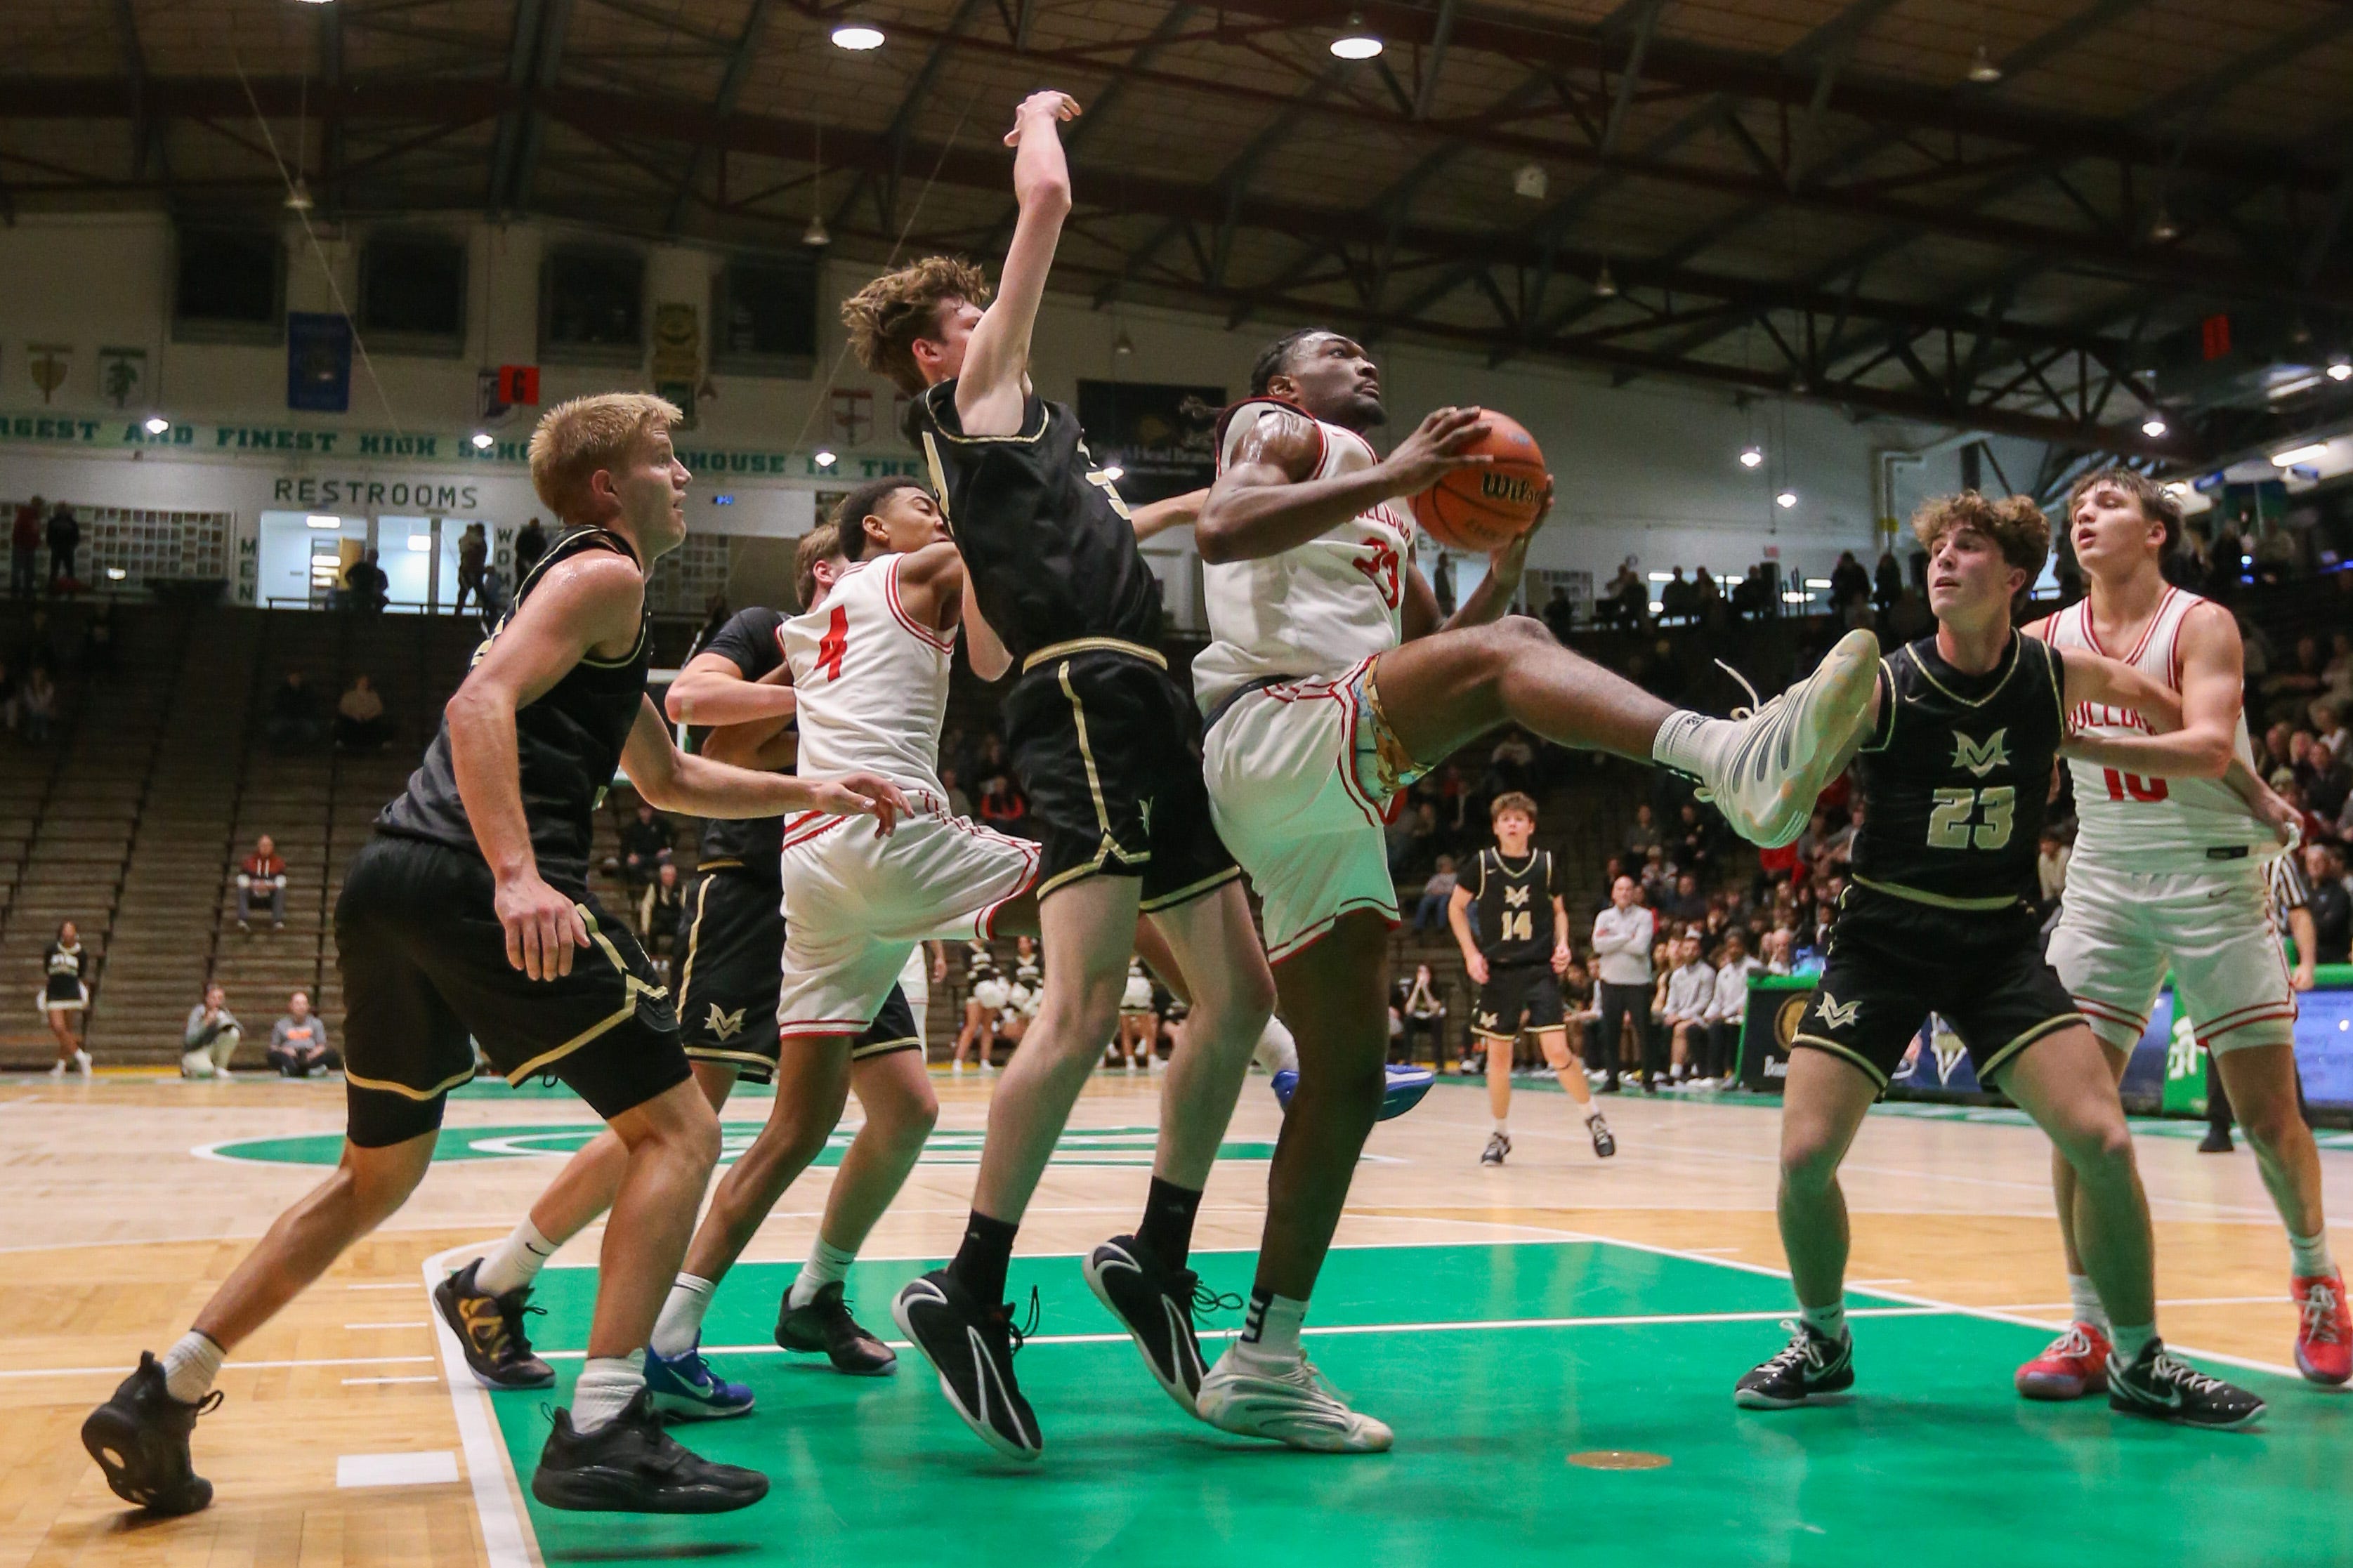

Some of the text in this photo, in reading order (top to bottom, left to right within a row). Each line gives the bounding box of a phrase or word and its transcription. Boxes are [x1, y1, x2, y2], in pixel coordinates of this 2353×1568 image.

[217, 426, 337, 452] FINEST
[859, 459, 918, 478] THE
[275, 478, 478, 509] RESTROOMS
[240, 537, 257, 601] MEN
[814, 605, 848, 683] 4
[1926, 785, 2016, 850] 23
[1501, 911, 1533, 942] 14
